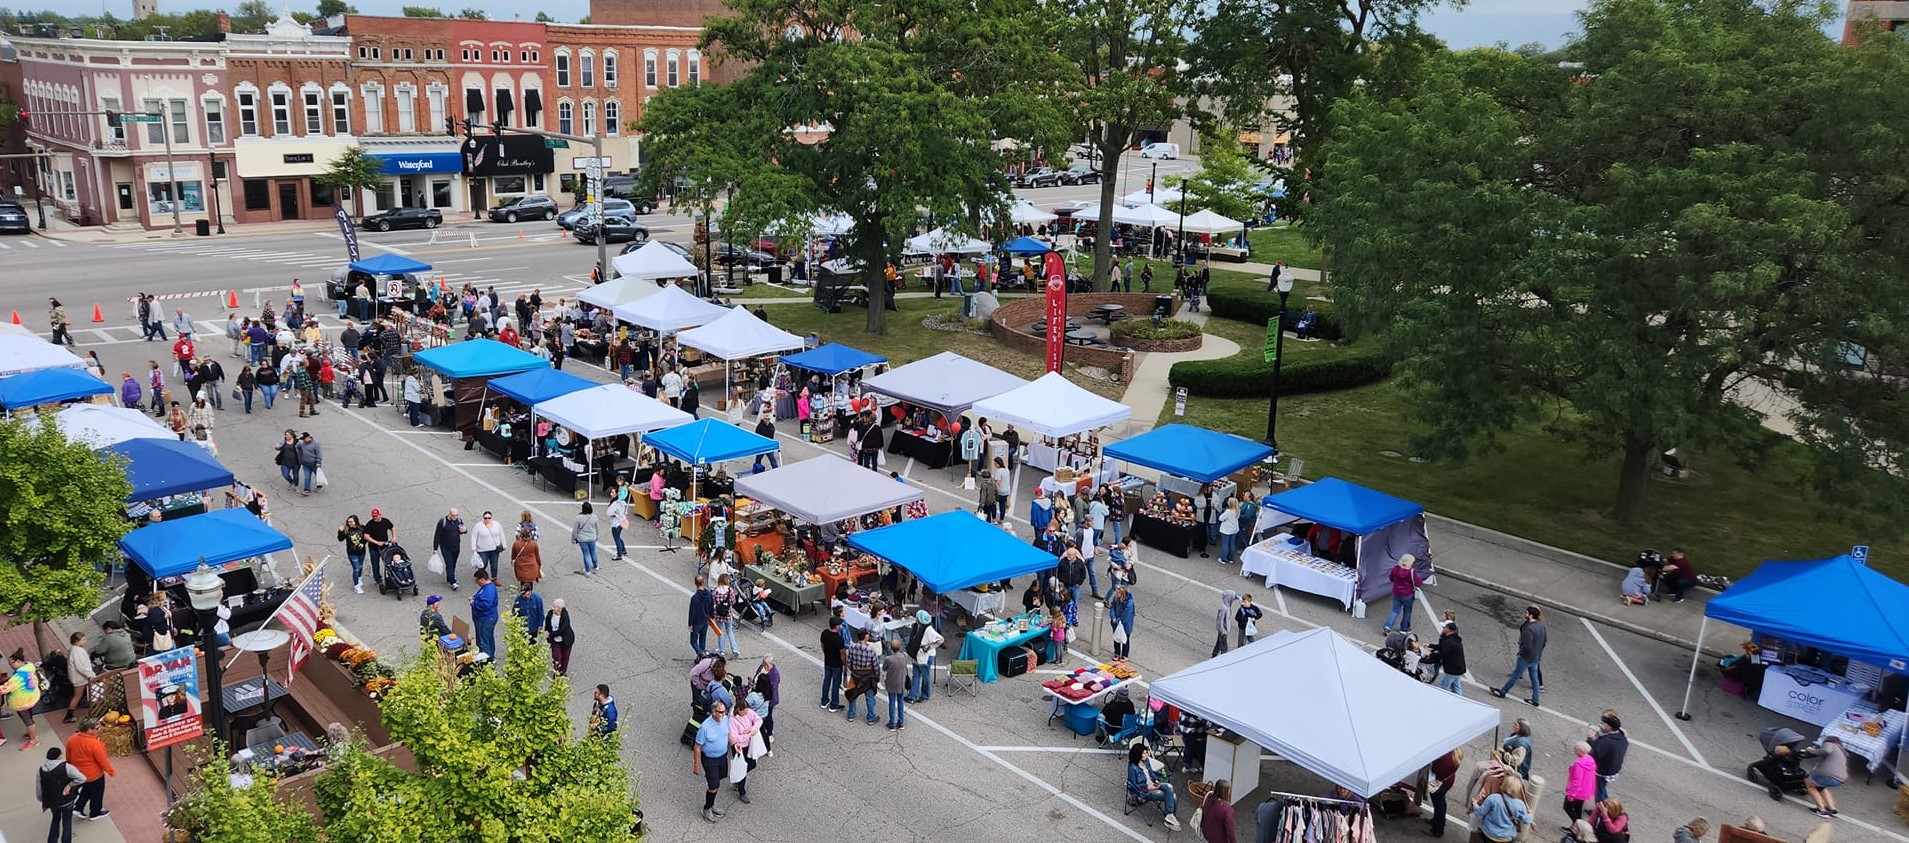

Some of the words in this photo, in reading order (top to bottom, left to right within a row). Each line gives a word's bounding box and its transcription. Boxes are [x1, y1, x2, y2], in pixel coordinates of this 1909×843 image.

[397, 159, 433, 171] Waterford
[181, 344, 190, 354] 2
[144, 656, 191, 677] BRYAN
[1788, 690, 1824, 705] color
